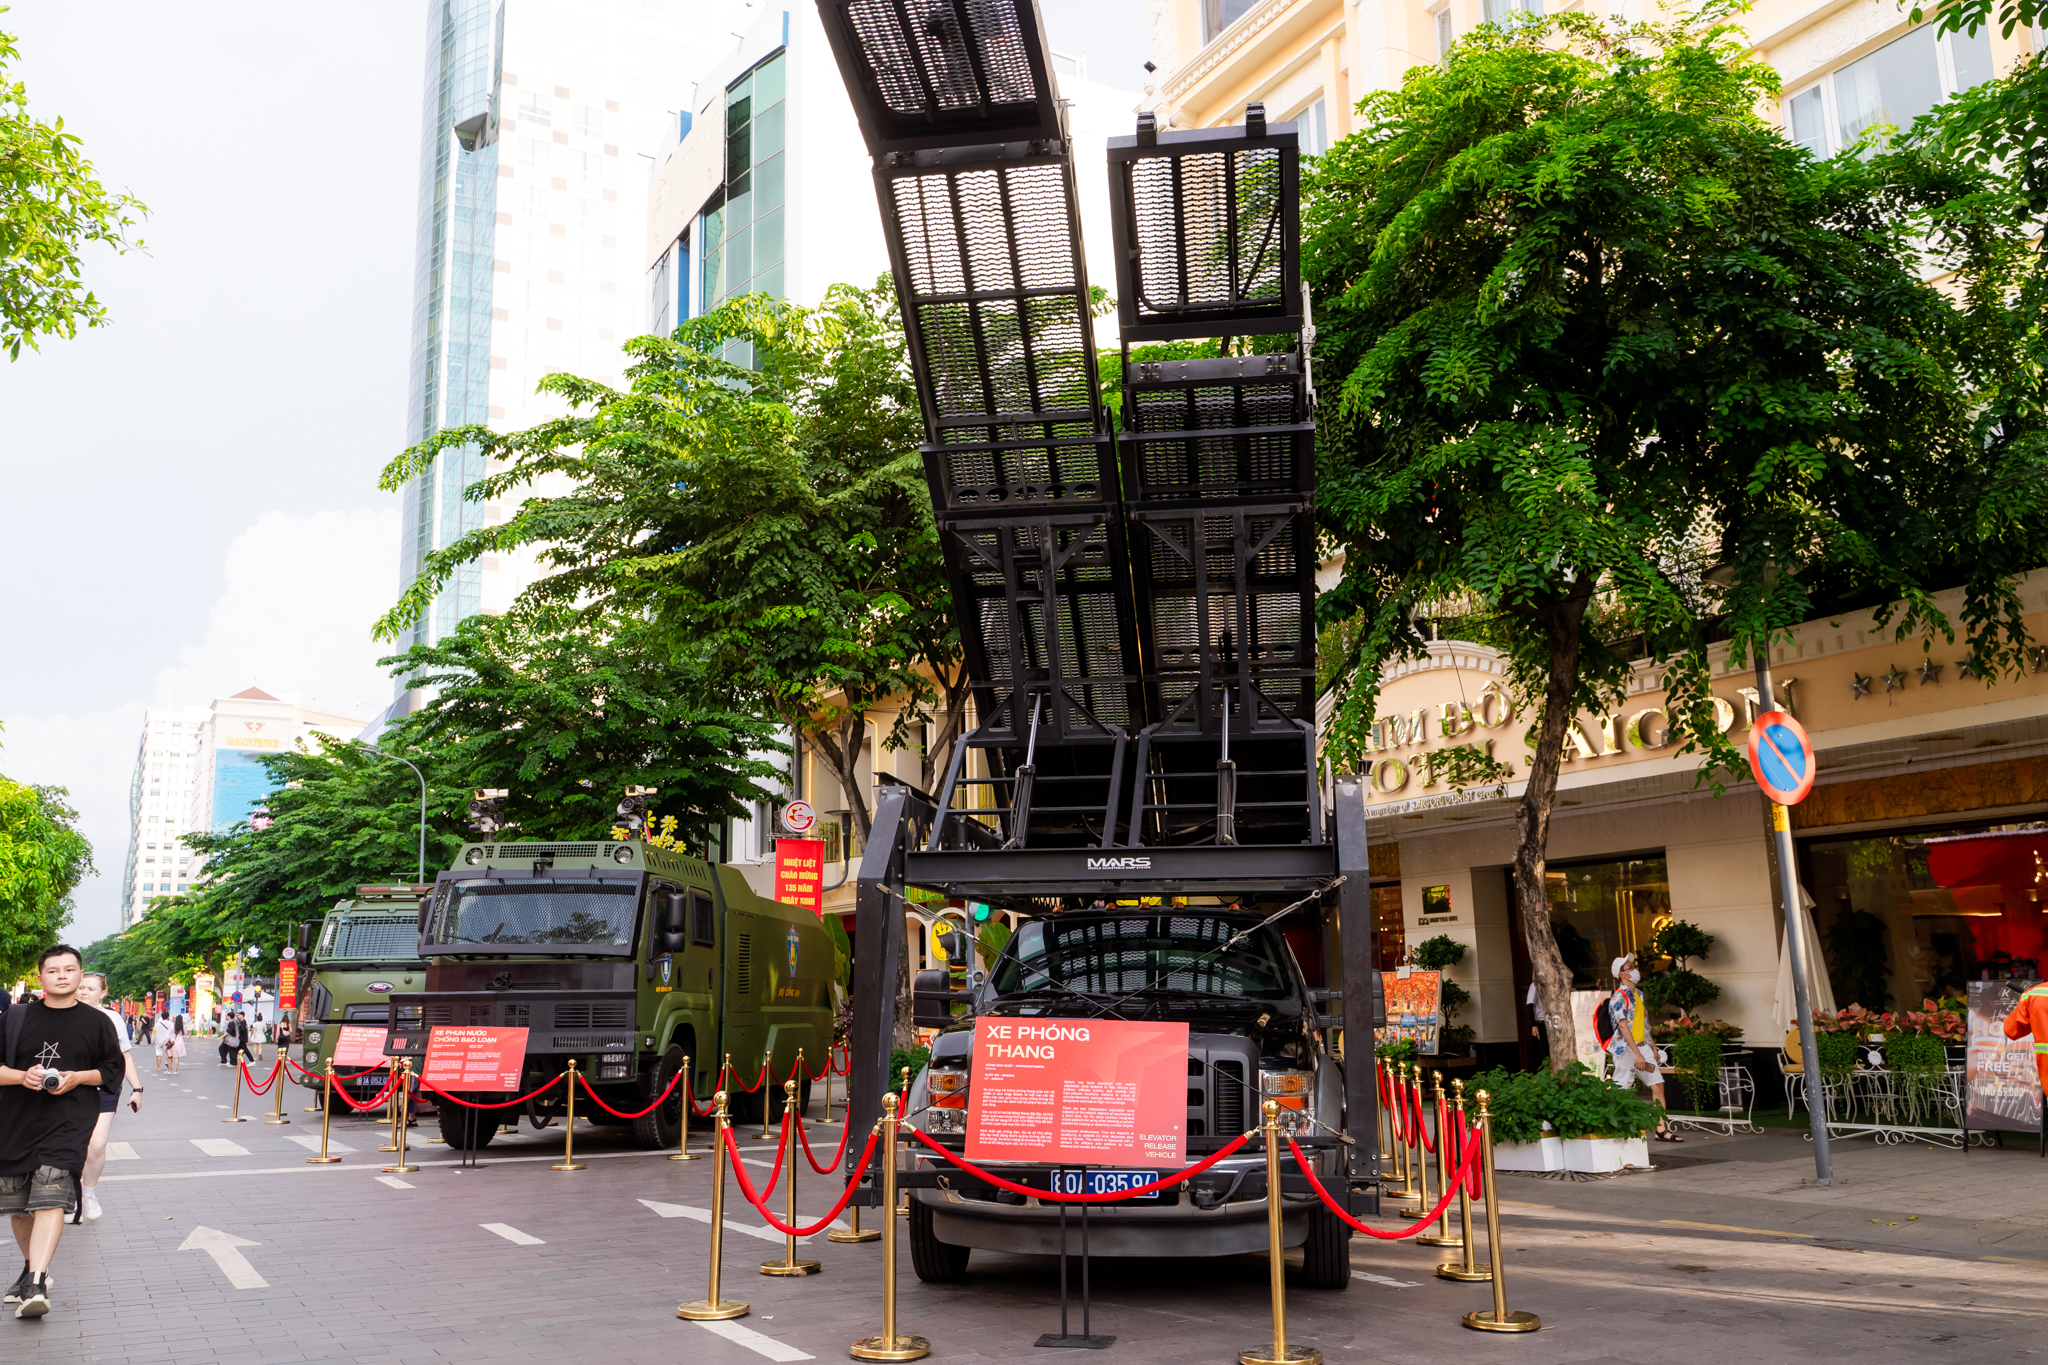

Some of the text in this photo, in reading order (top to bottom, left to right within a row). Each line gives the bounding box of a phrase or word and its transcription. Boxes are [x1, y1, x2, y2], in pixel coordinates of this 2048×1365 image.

[1364, 680, 1511, 753] IM ĐÔ
[227, 737, 279, 748] SAIGON PRINCE
[1371, 805, 1400, 816] member
[1402, 802, 1409, 811] of
[784, 858, 816, 868] NHIỆT LIỆT
[1088, 857, 1151, 867] MARS
[781, 871, 797, 879] CHÀO
[798, 884, 812, 892] NĂM
[782, 895, 815, 905] NGÀY SINH
[987, 1024, 1090, 1042] XE PHÓNG
[986, 1044, 1055, 1059] THANG
[1977, 1062, 2010, 1072] FREE
